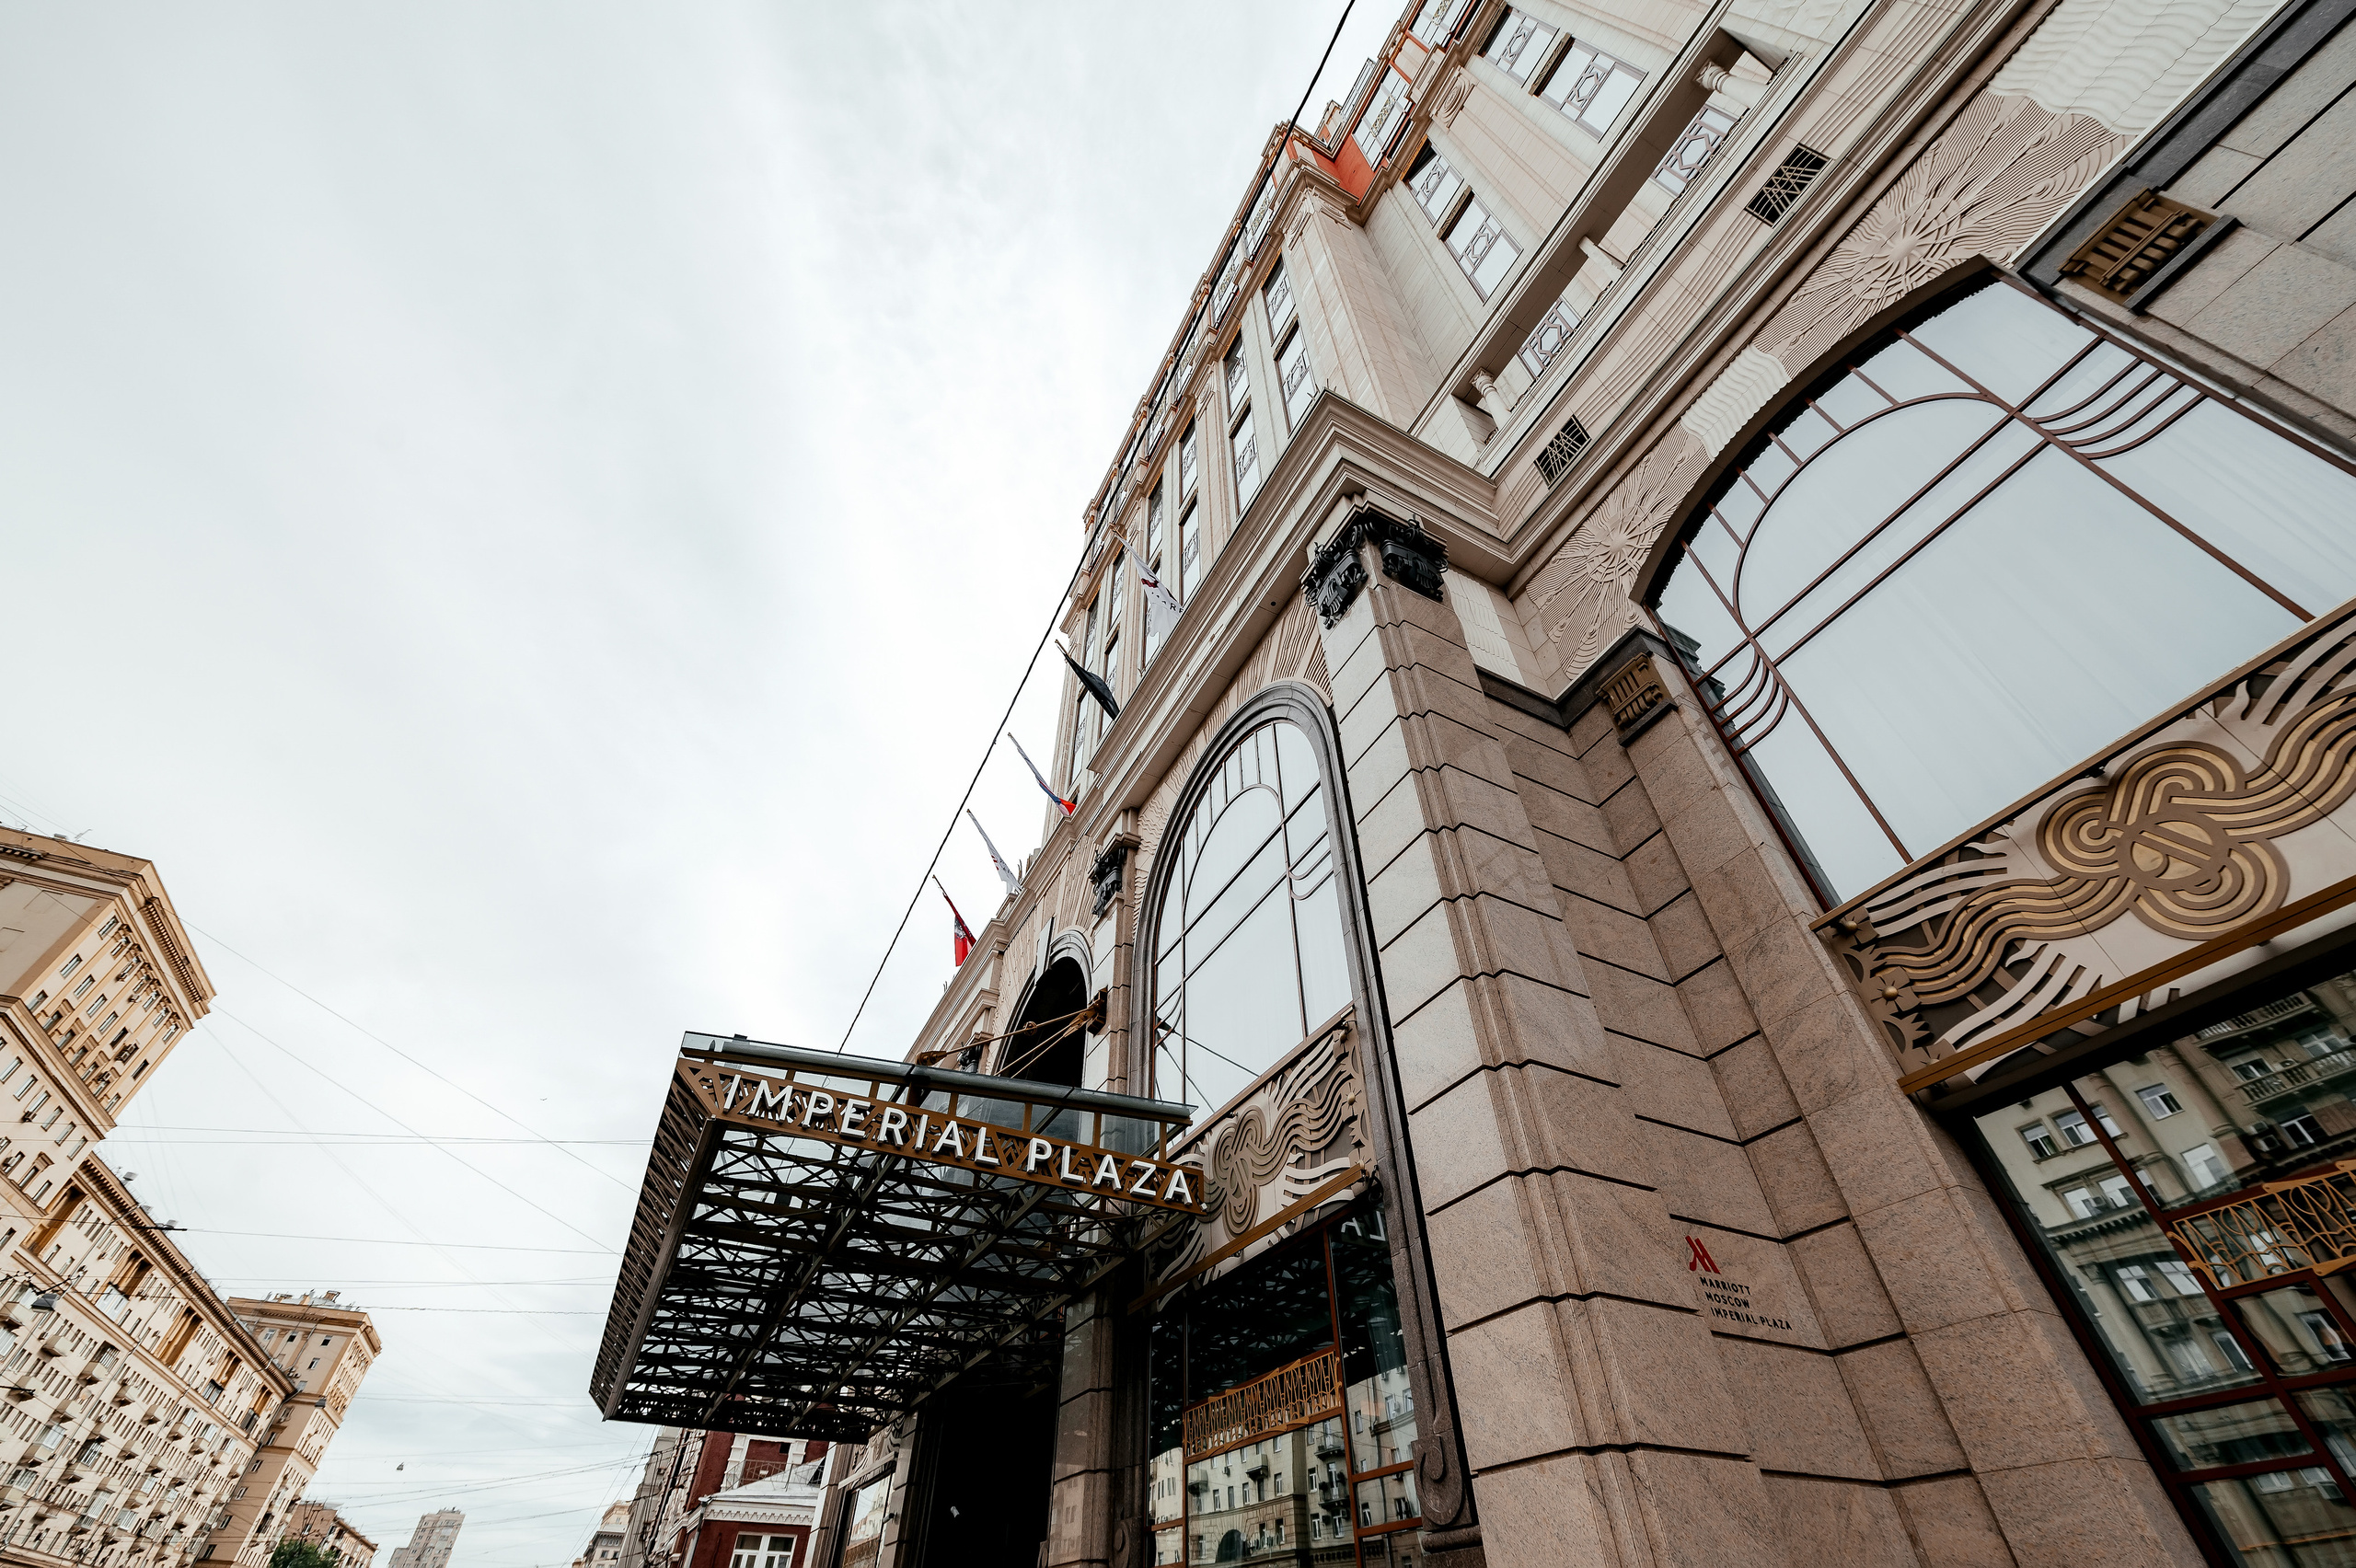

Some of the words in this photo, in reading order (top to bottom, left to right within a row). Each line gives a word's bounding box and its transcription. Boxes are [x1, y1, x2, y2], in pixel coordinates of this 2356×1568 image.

[722, 1073, 999, 1167] IMPERIAL
[1026, 1138, 1195, 1206] PLAZA
[1700, 1276, 1751, 1295] MARRIOTT
[1704, 1291, 1750, 1309] MOSCOW
[1711, 1307, 1758, 1325] IMPERIAL
[1759, 1316, 1793, 1331] PLAZA
